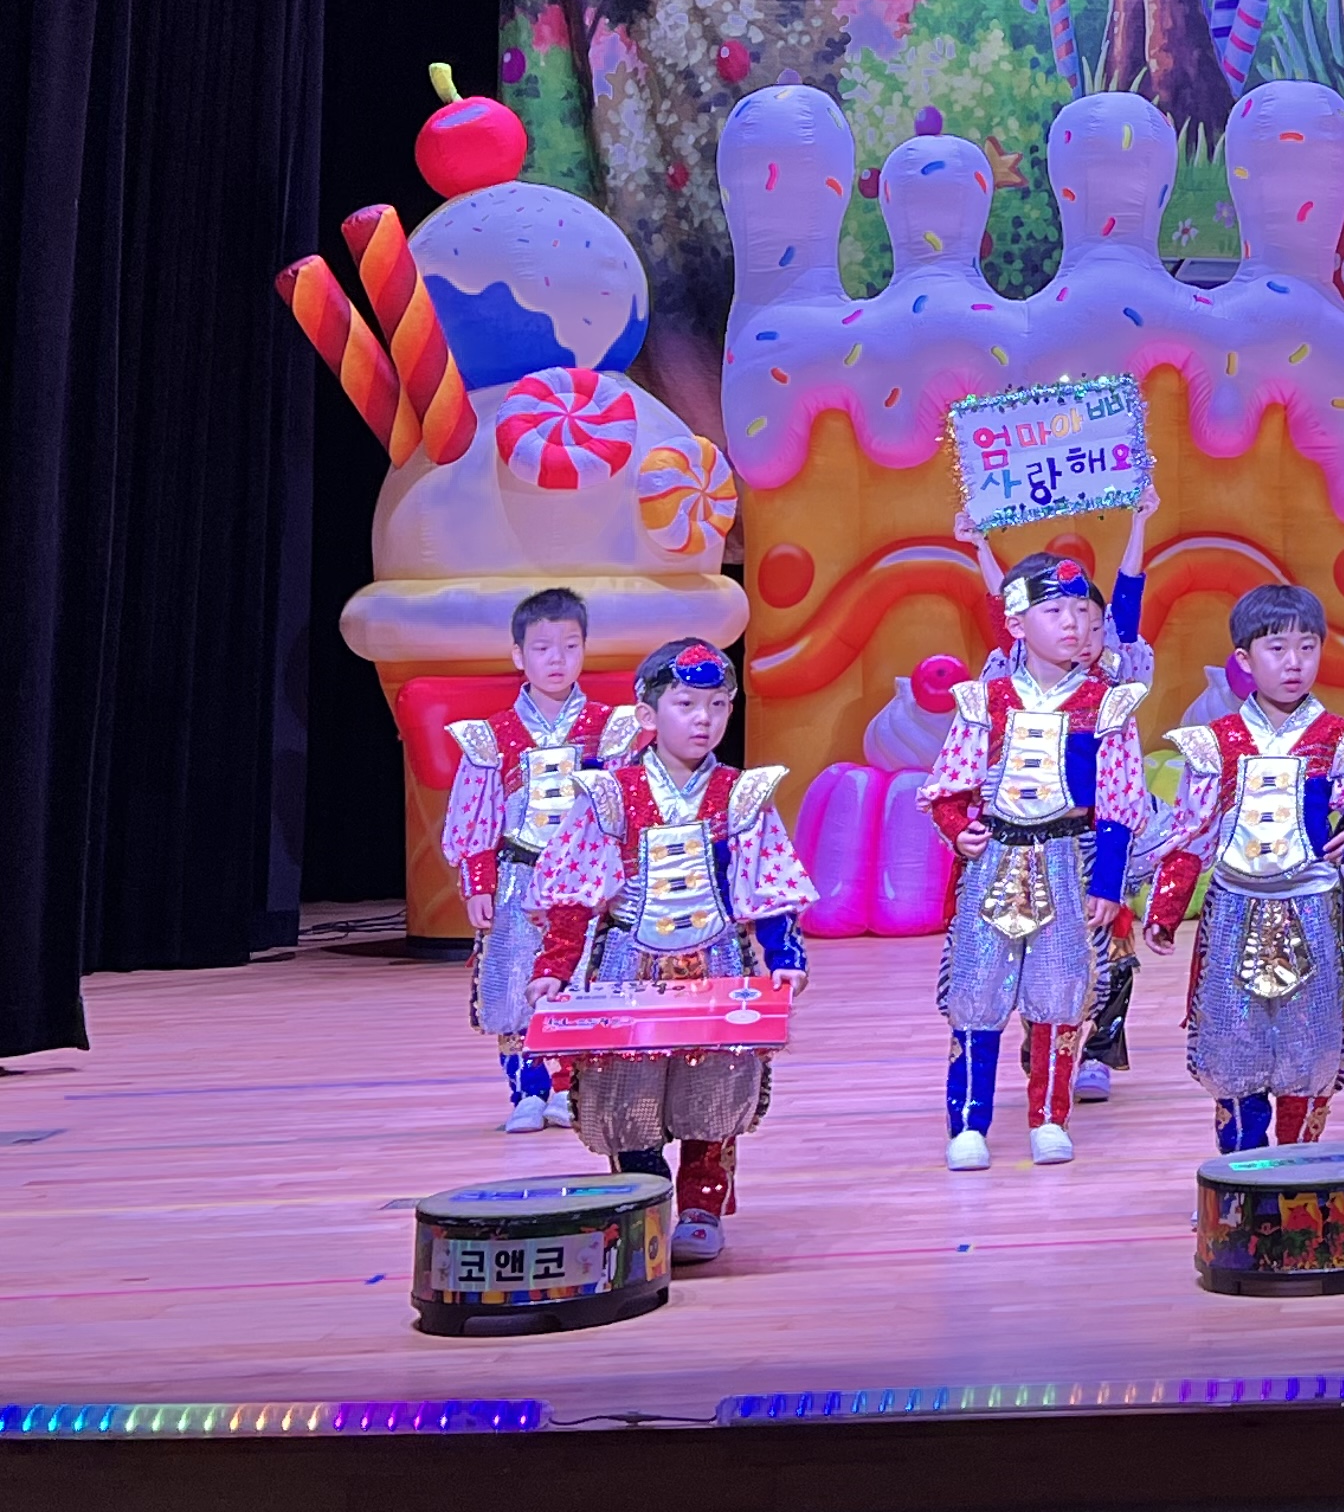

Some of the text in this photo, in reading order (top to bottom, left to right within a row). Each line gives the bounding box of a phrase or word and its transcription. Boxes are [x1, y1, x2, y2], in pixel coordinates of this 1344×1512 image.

[972, 392, 1133, 472] 엄마아빠
[979, 443, 1133, 506] 사랑해요
[457, 1246, 566, 1283] 코앤코
